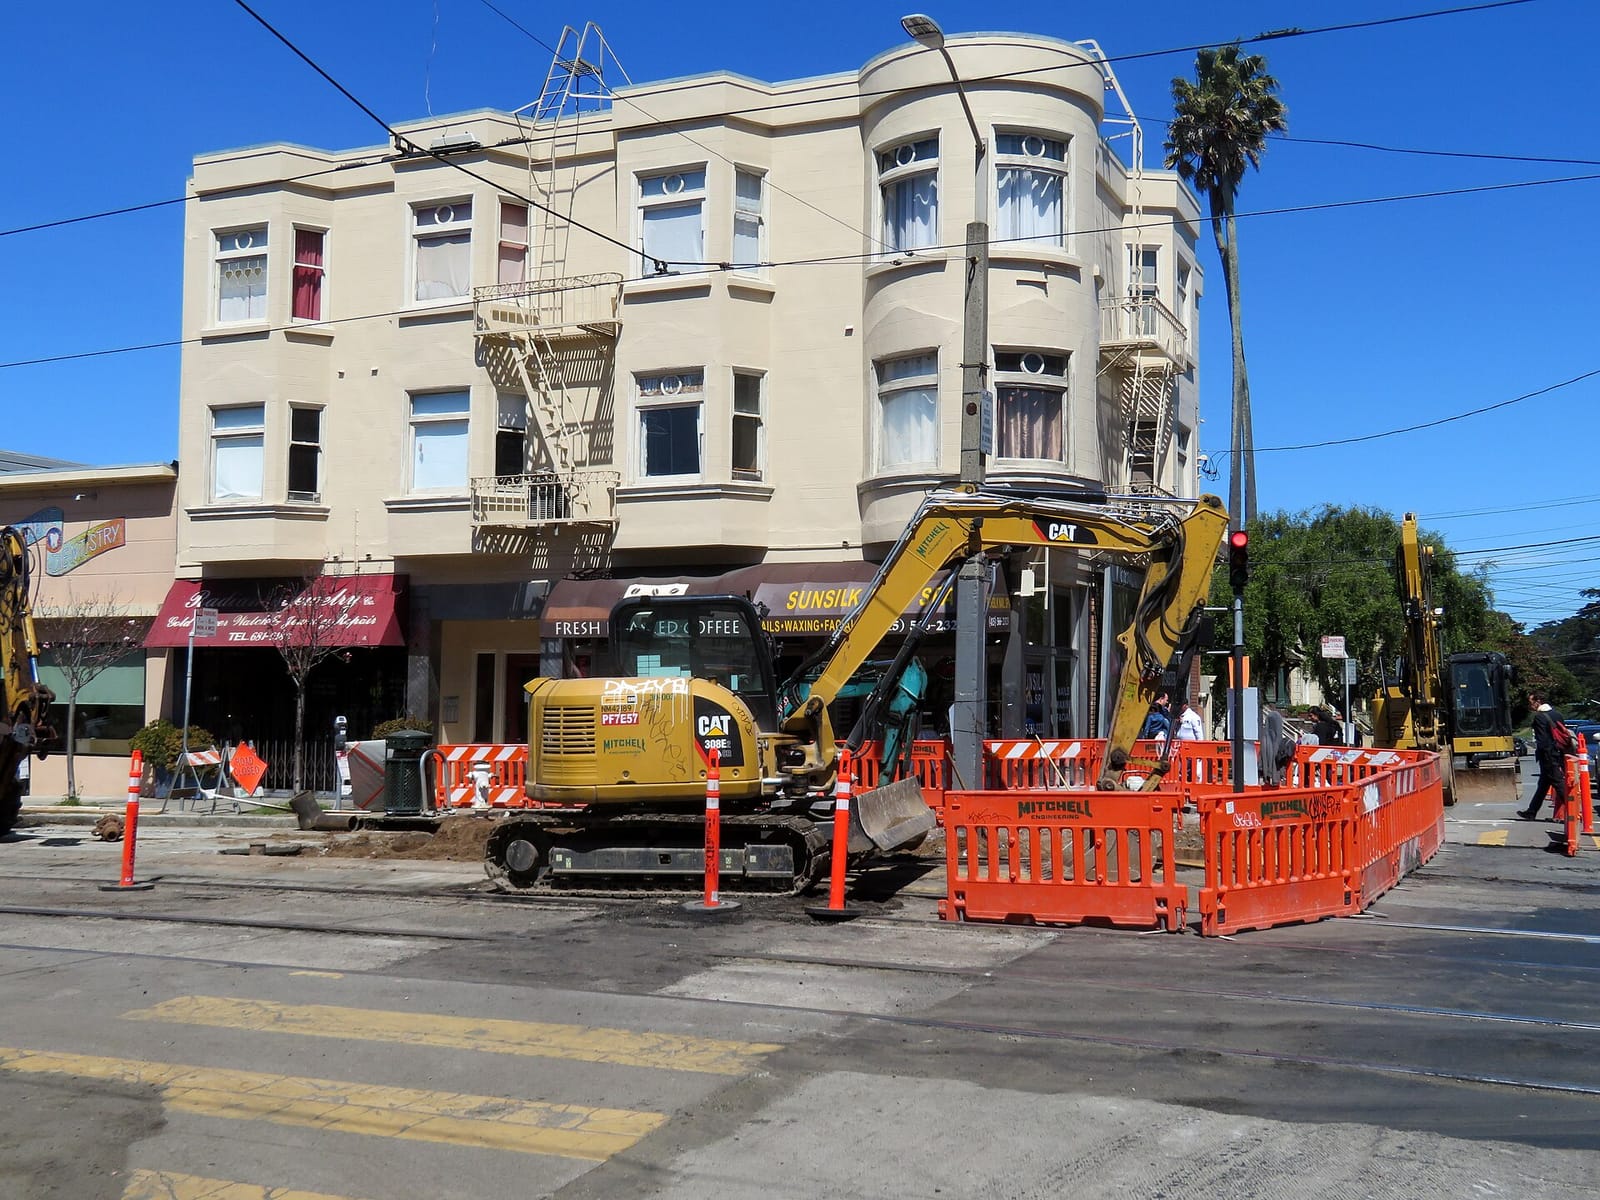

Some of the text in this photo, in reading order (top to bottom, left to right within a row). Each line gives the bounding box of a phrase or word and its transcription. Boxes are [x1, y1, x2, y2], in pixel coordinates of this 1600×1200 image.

[916, 521, 950, 559] MITCHELL
[1048, 523, 1077, 541] CAT
[786, 588, 862, 610] SUNSILK
[334, 613, 377, 629] Repair
[555, 622, 601, 635] FRESH
[761, 620, 781, 633] AILS
[784, 620, 820, 632] WAXING
[602, 713, 639, 725] PF7E57
[698, 715, 731, 736] CAT
[603, 738, 646, 754] MITCHELL
[233, 765, 260, 777] CLOSED
[1017, 800, 1093, 819] MITCHELL
[1261, 799, 1309, 821] MITCHELL
